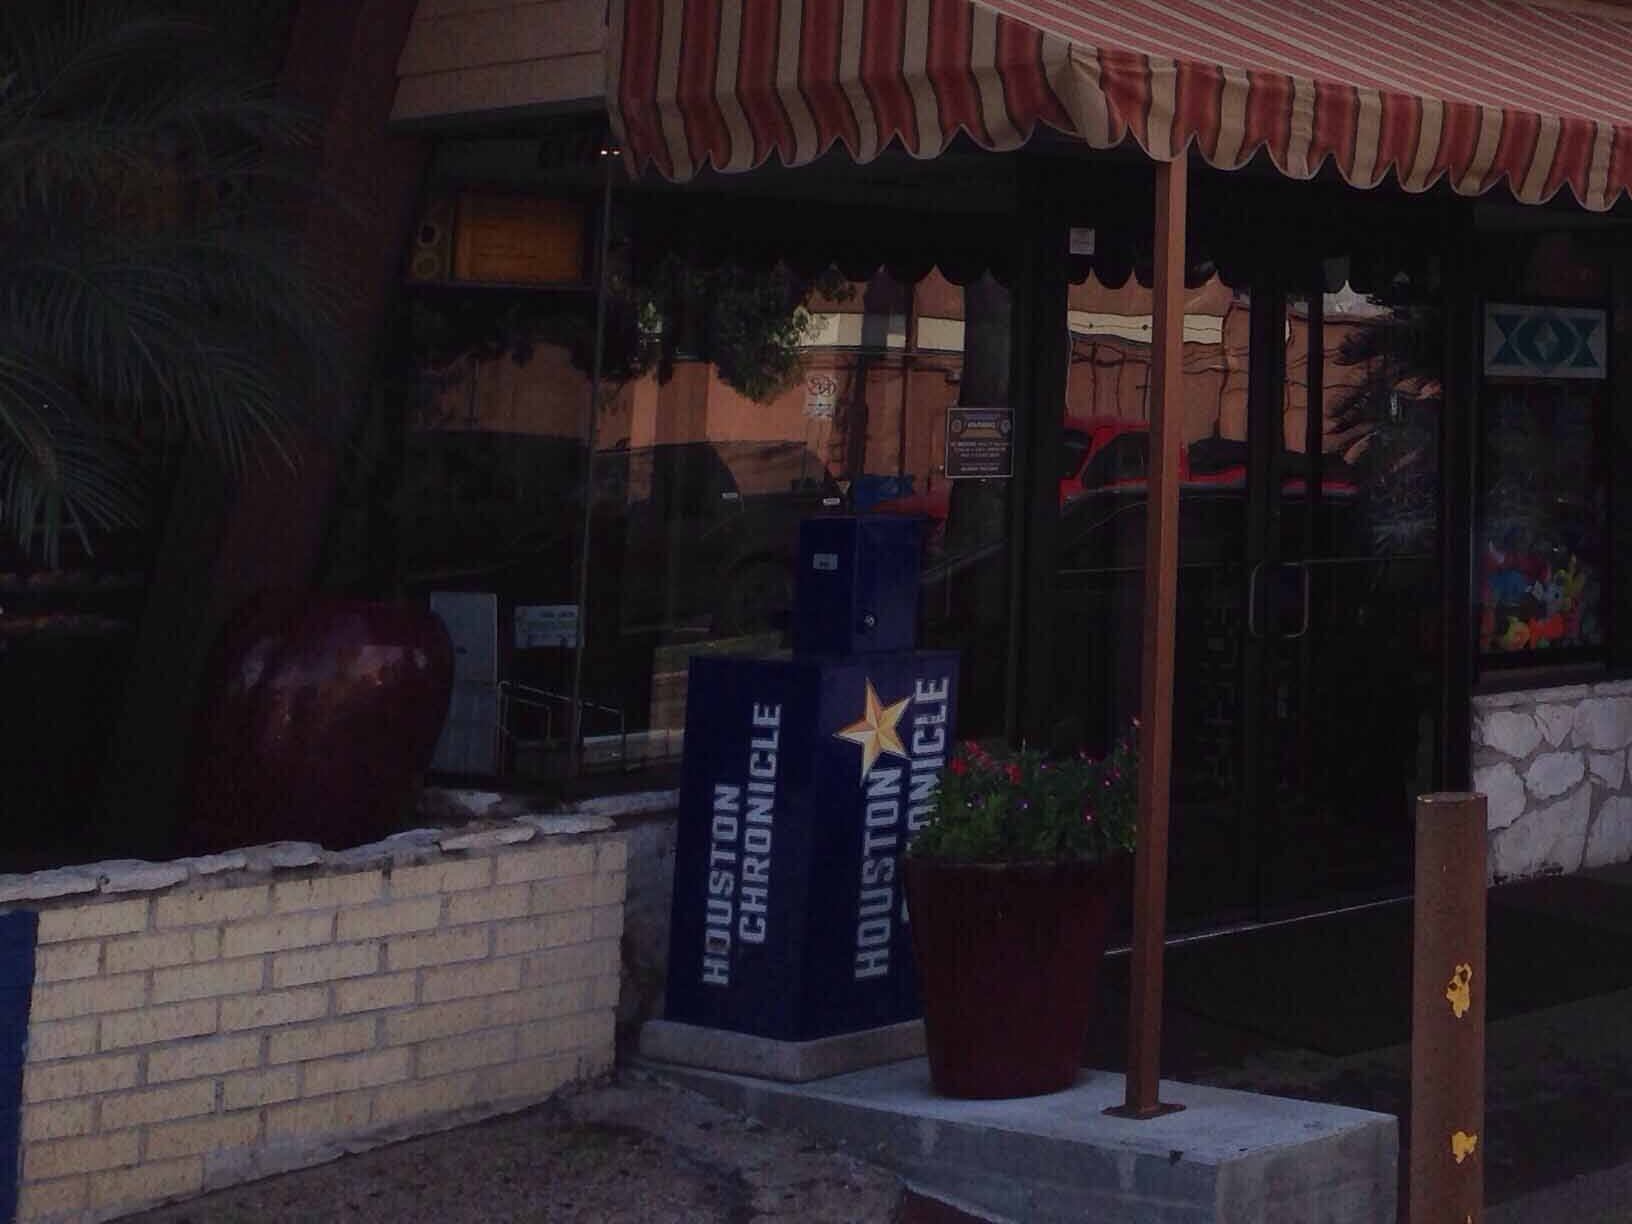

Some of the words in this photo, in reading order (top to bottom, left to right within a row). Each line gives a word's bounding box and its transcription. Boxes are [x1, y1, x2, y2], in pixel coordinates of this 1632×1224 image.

[702, 782, 742, 986] HOUSTON
[738, 702, 782, 945] CHRONICLE
[854, 766, 901, 979] HOUSTON
